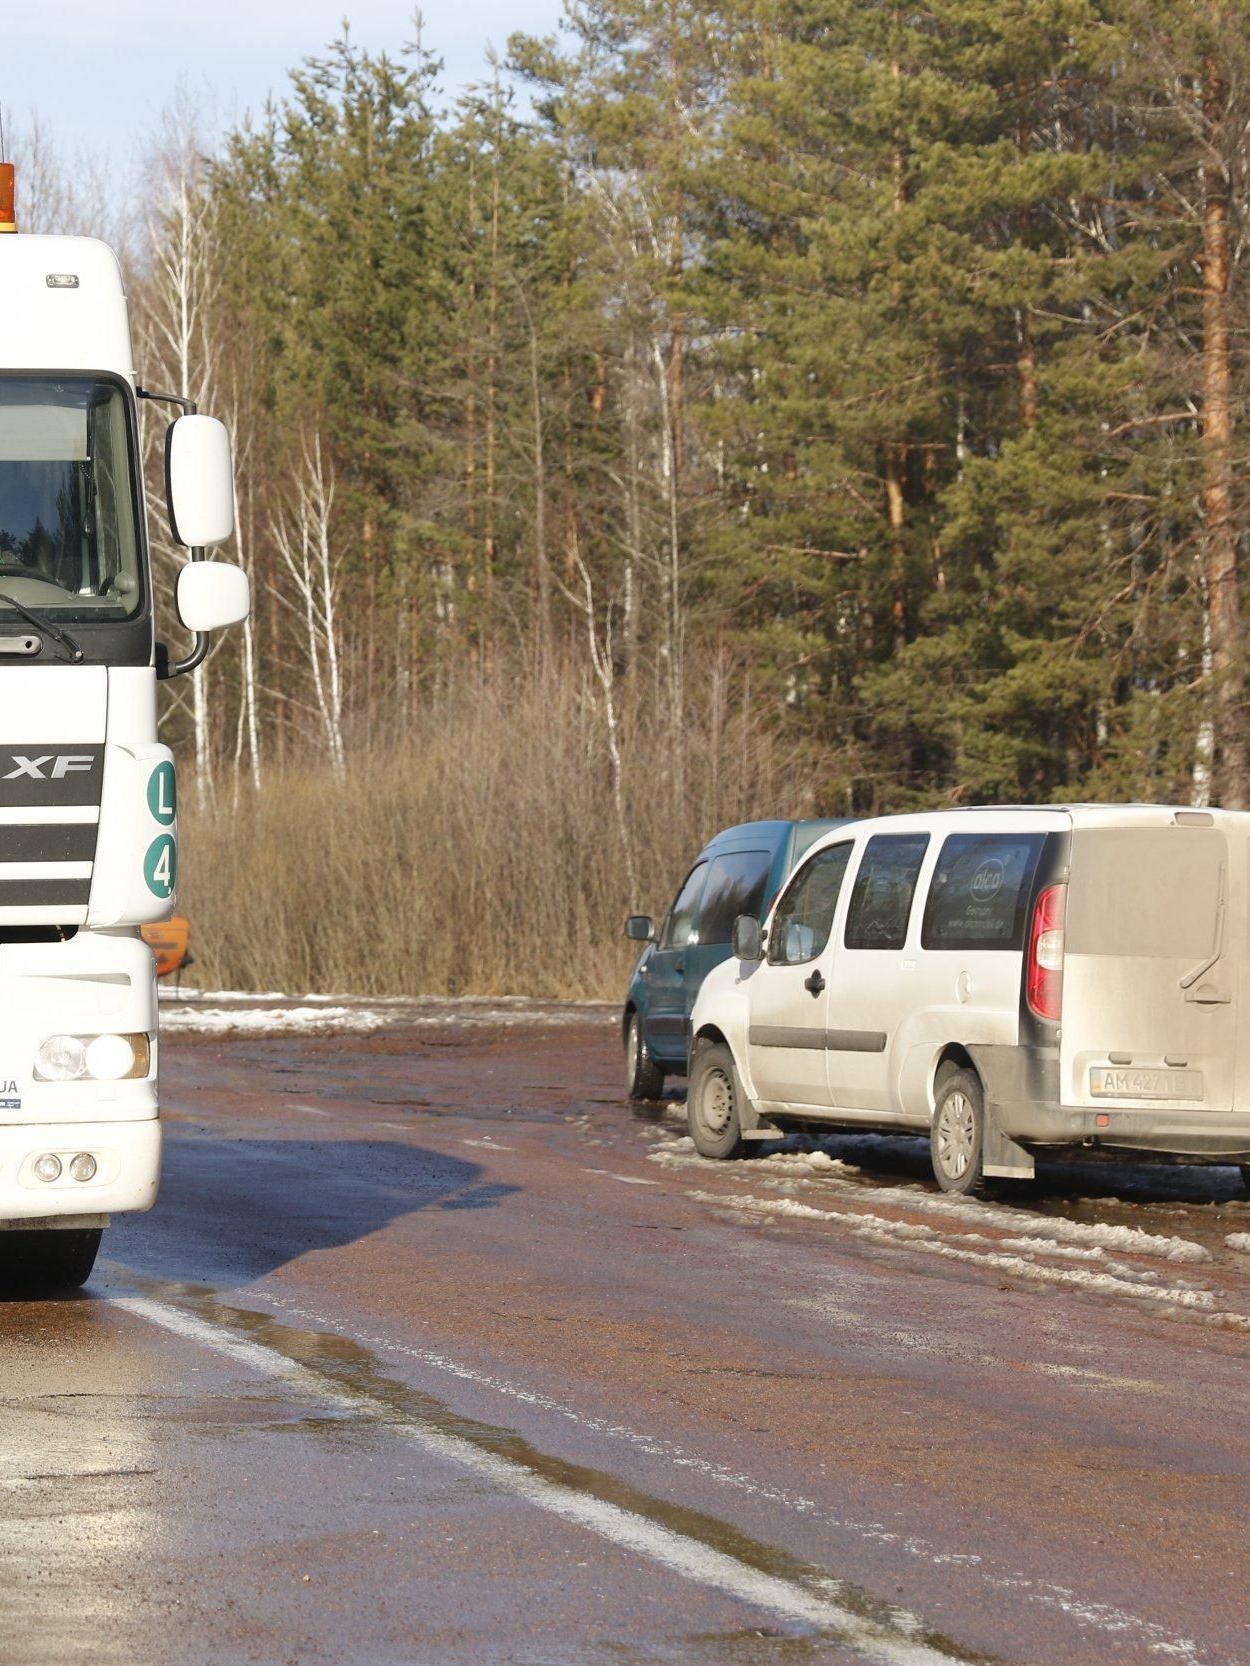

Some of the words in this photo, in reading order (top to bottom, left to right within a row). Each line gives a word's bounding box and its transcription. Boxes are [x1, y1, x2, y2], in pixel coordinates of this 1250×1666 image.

[1, 756, 95, 779] XF
[158, 771, 173, 815] L
[153, 844, 171, 887] 4
[973, 868, 1001, 889] alca
